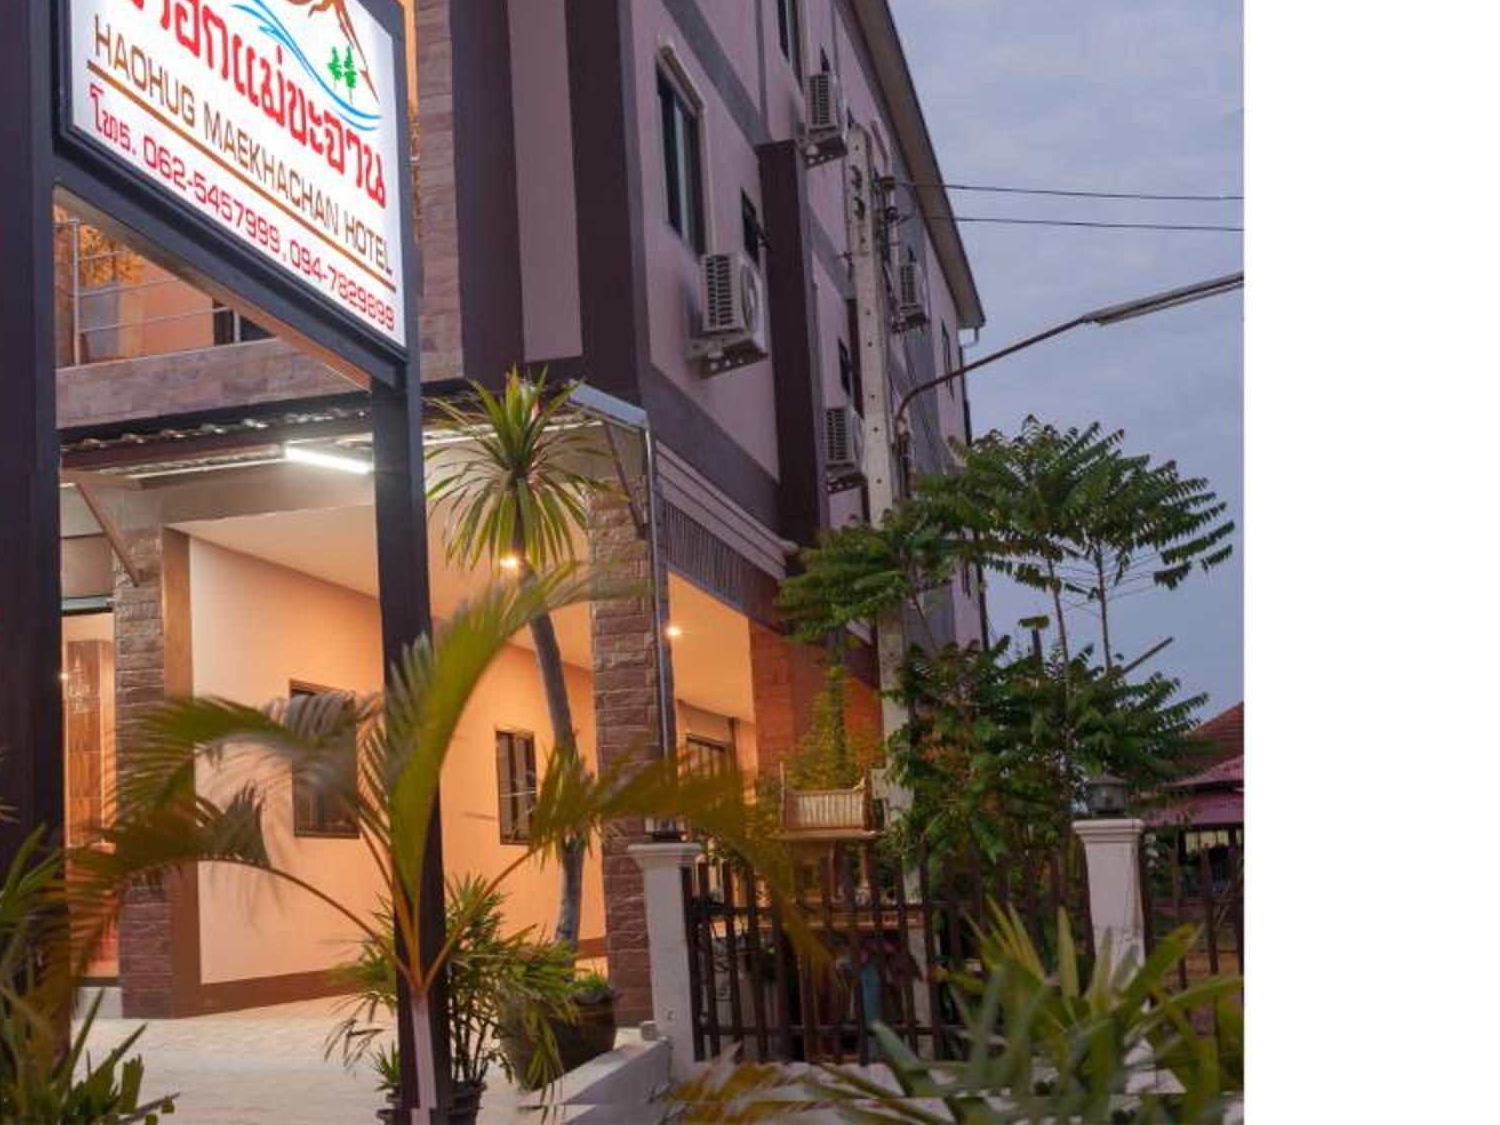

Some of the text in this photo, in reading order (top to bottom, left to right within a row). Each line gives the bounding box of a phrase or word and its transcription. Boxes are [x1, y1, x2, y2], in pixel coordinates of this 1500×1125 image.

[88, 82, 137, 156] โทร.
[94, 13, 393, 276] HAOHUG MAEKHACHAN HOTEL
